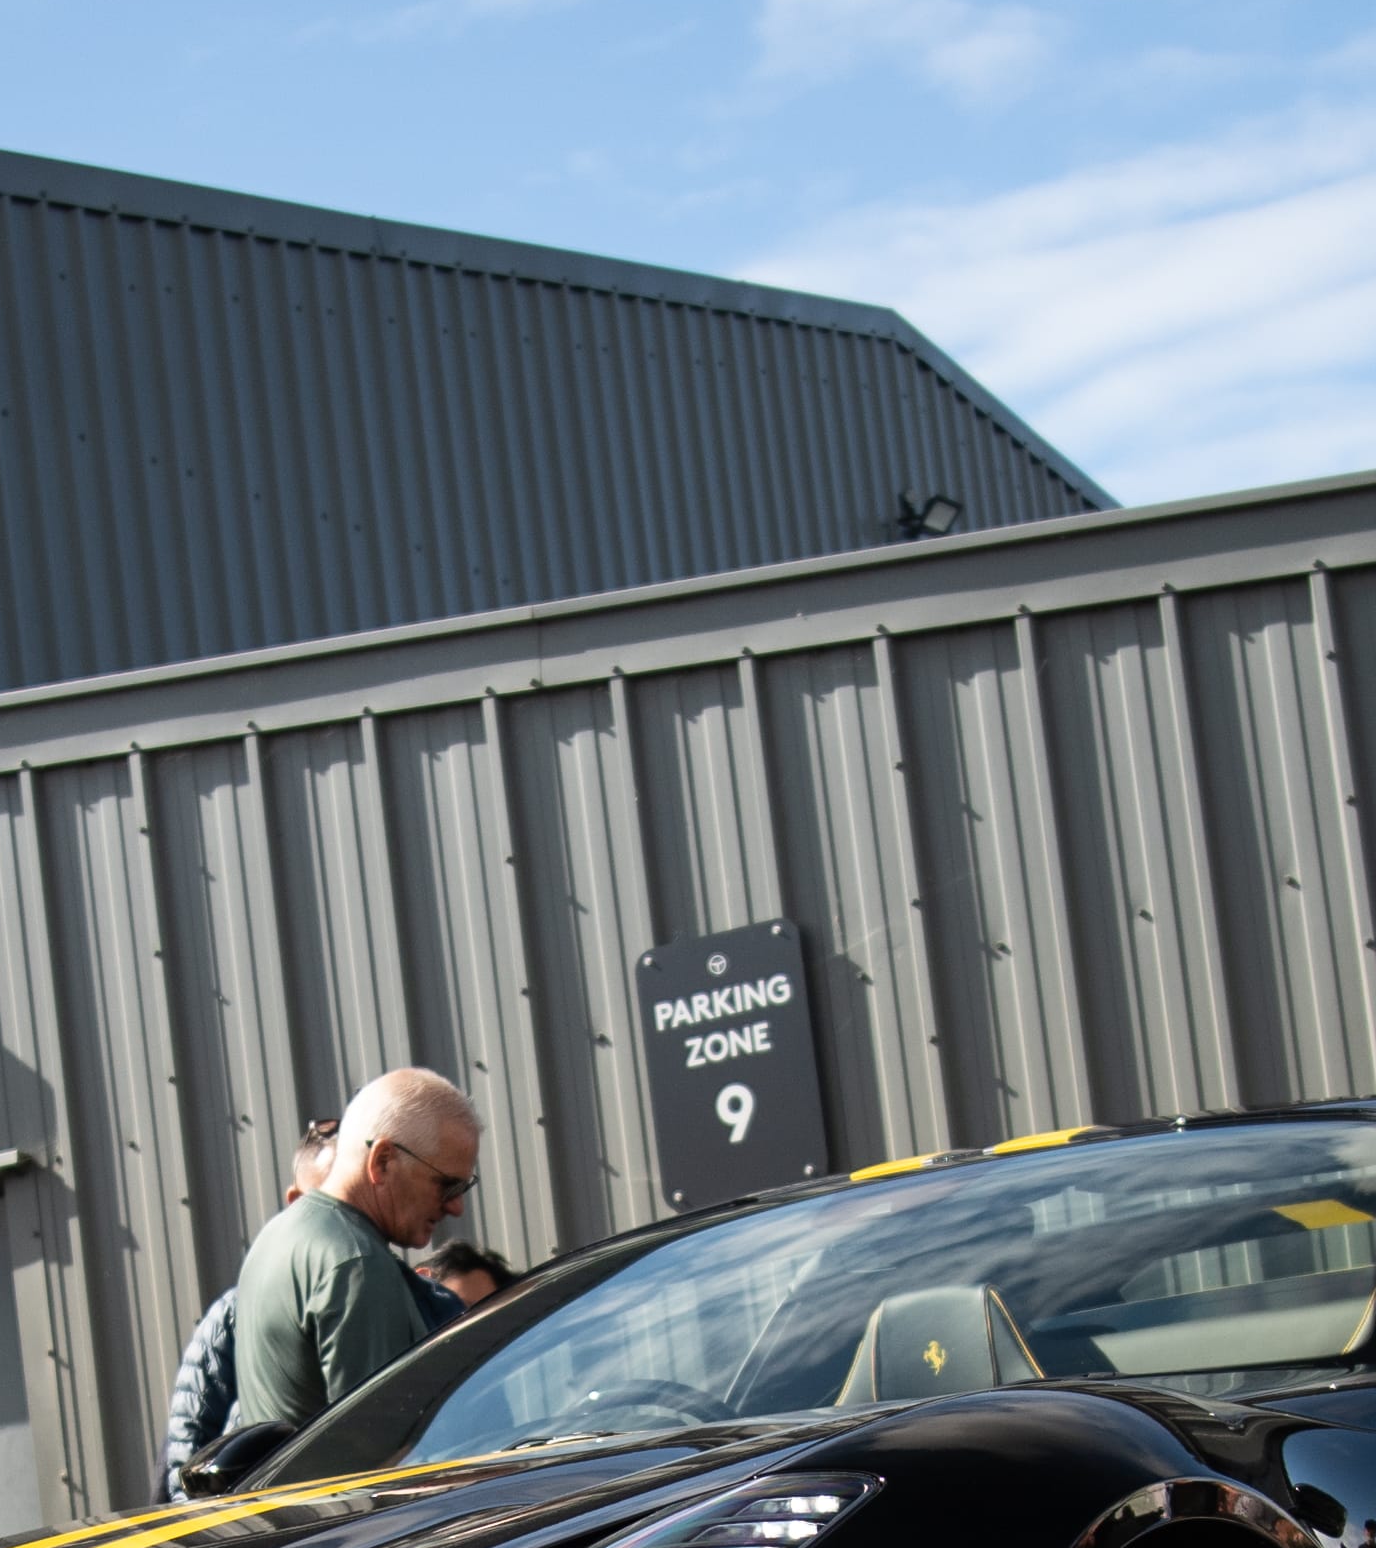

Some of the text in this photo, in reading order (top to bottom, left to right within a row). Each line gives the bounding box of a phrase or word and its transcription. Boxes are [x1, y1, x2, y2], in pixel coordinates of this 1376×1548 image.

[654, 974, 791, 1032] PARKING
[685, 1022, 772, 1068] ZONE
[715, 1083, 755, 1143] 9
